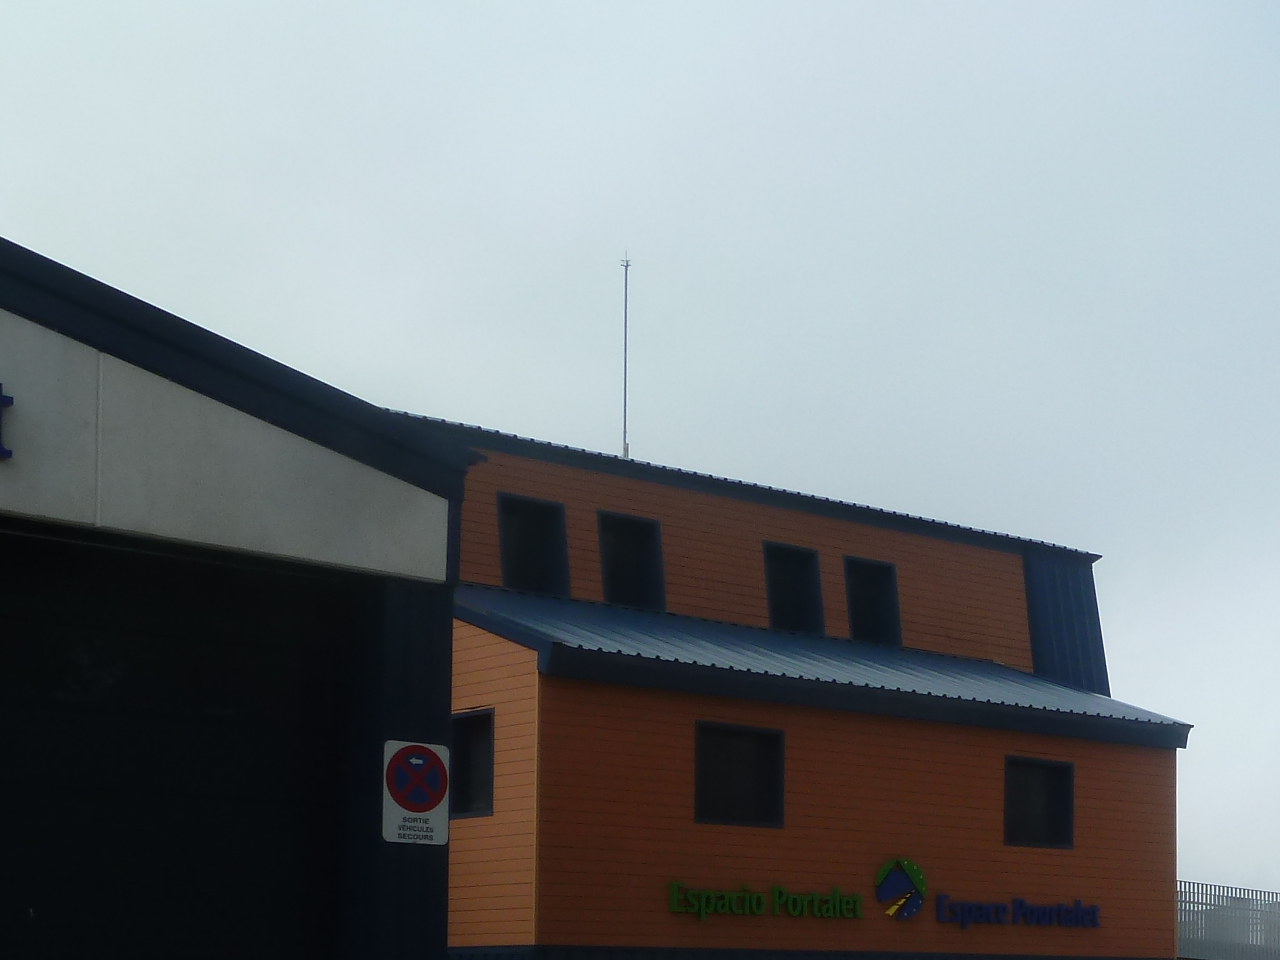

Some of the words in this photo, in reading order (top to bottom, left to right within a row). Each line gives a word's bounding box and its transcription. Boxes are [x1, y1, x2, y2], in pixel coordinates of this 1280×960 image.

[402, 816, 430, 824] SORTIE
[397, 832, 434, 841] SECOURS
[669, 882, 765, 921] Espacio
[770, 885, 863, 919] Portalet
[935, 893, 1009, 930] Espace
[1011, 897, 1100, 928] Pourtalet
